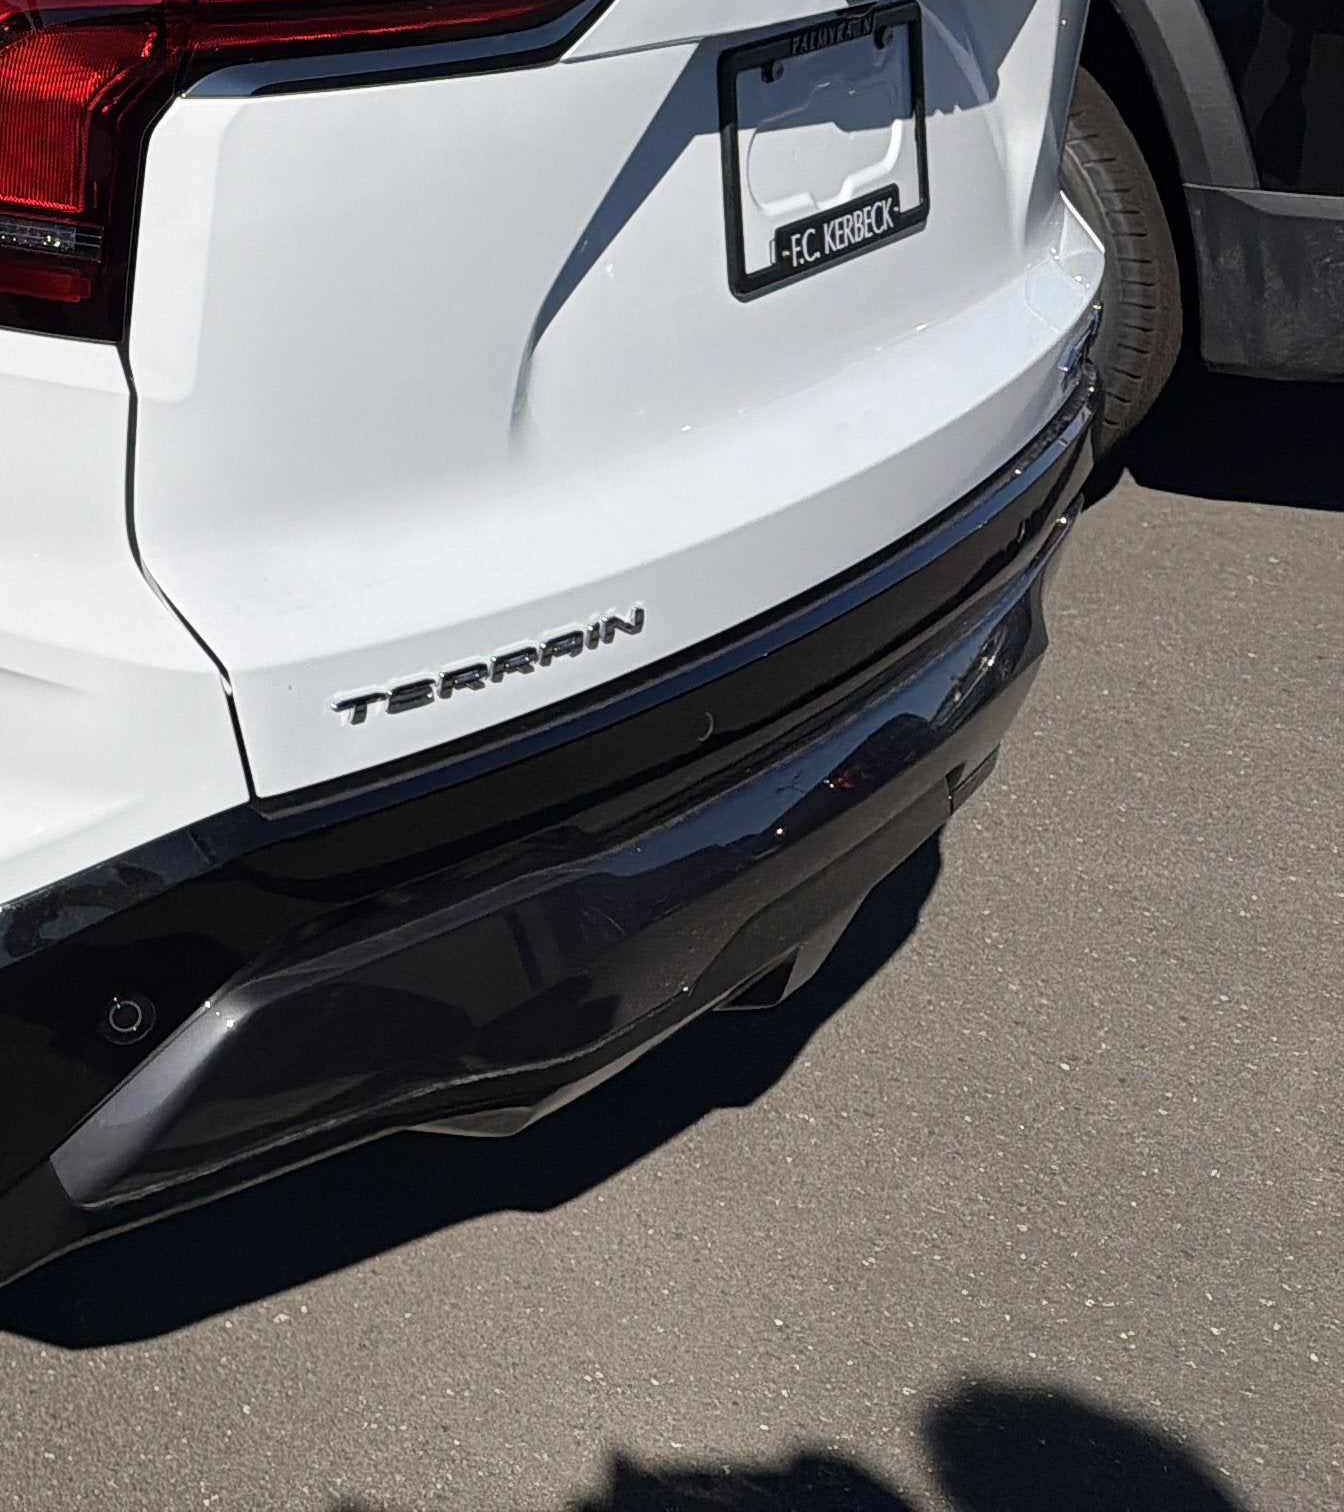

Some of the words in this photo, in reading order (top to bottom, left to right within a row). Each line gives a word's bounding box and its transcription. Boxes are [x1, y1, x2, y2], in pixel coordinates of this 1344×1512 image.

[790, 228, 821, 267] F.C.
[823, 197, 895, 255] KERBECK
[329, 605, 645, 726] TERRAIN
